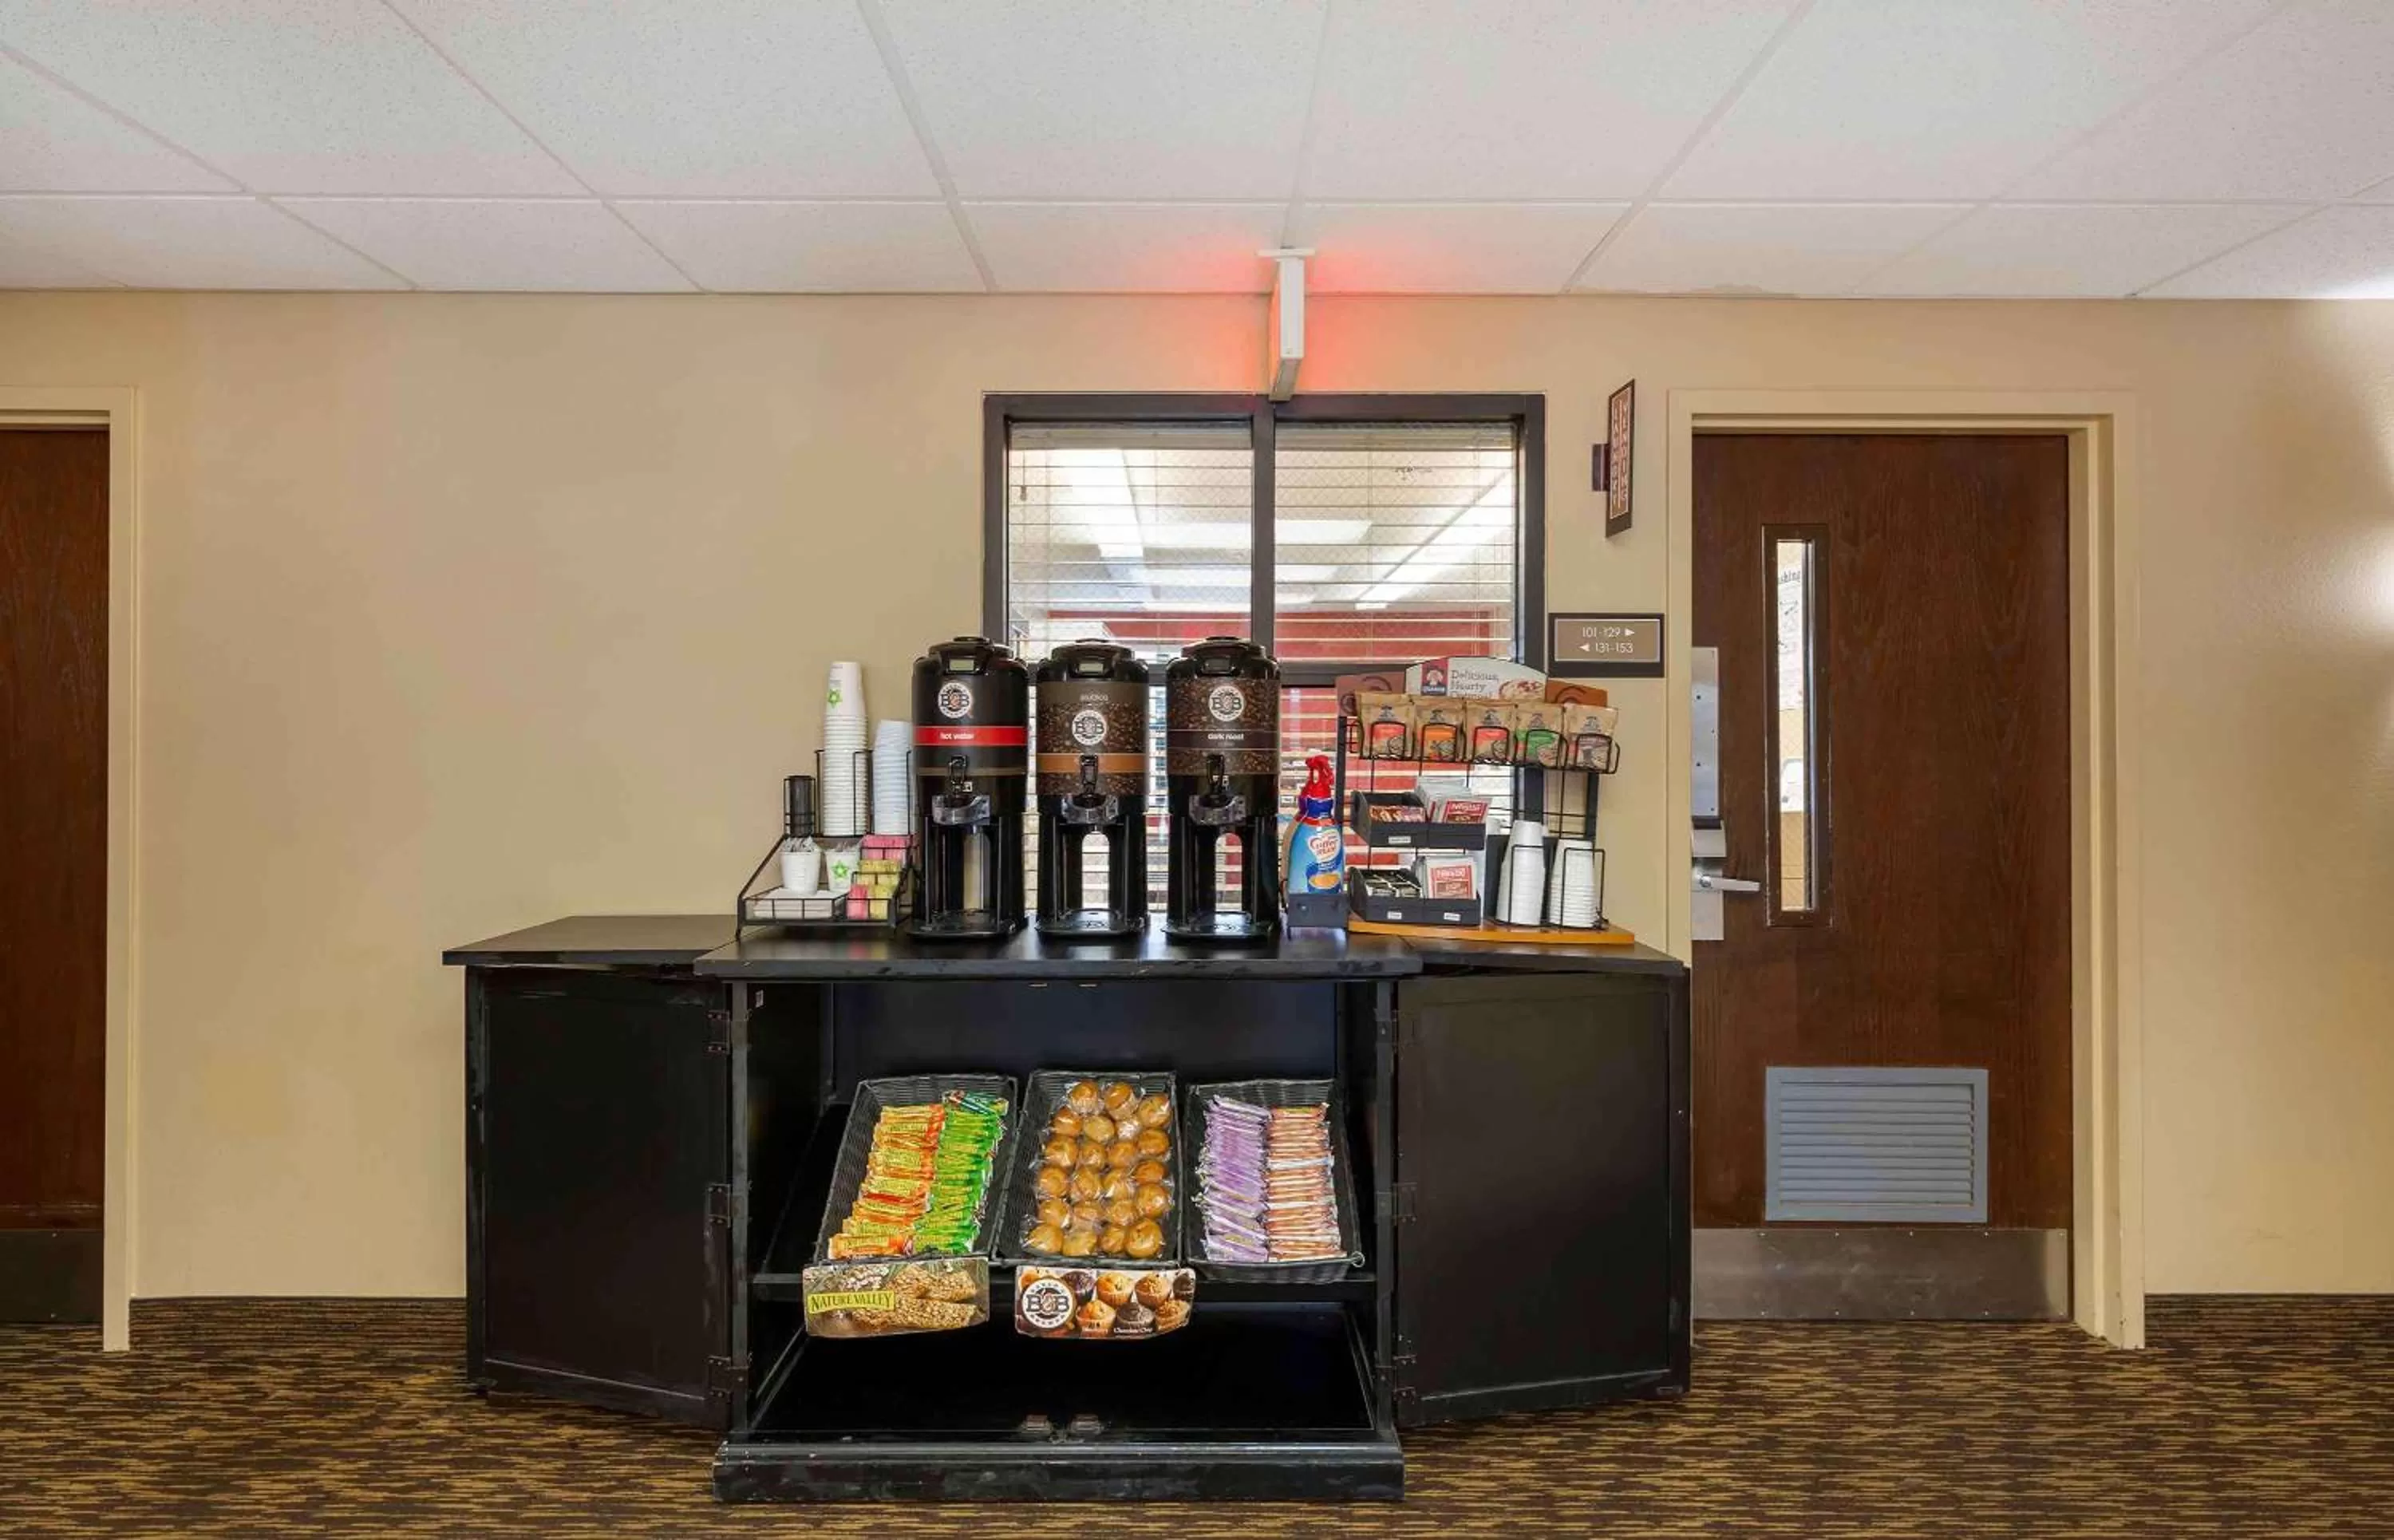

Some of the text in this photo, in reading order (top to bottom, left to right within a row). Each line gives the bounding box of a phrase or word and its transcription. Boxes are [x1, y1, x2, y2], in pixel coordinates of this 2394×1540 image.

[1582, 626, 1621, 638] 101-129
[1595, 642, 1634, 654] 131-153
[810, 1292, 894, 1310] NATURE VALLEY
